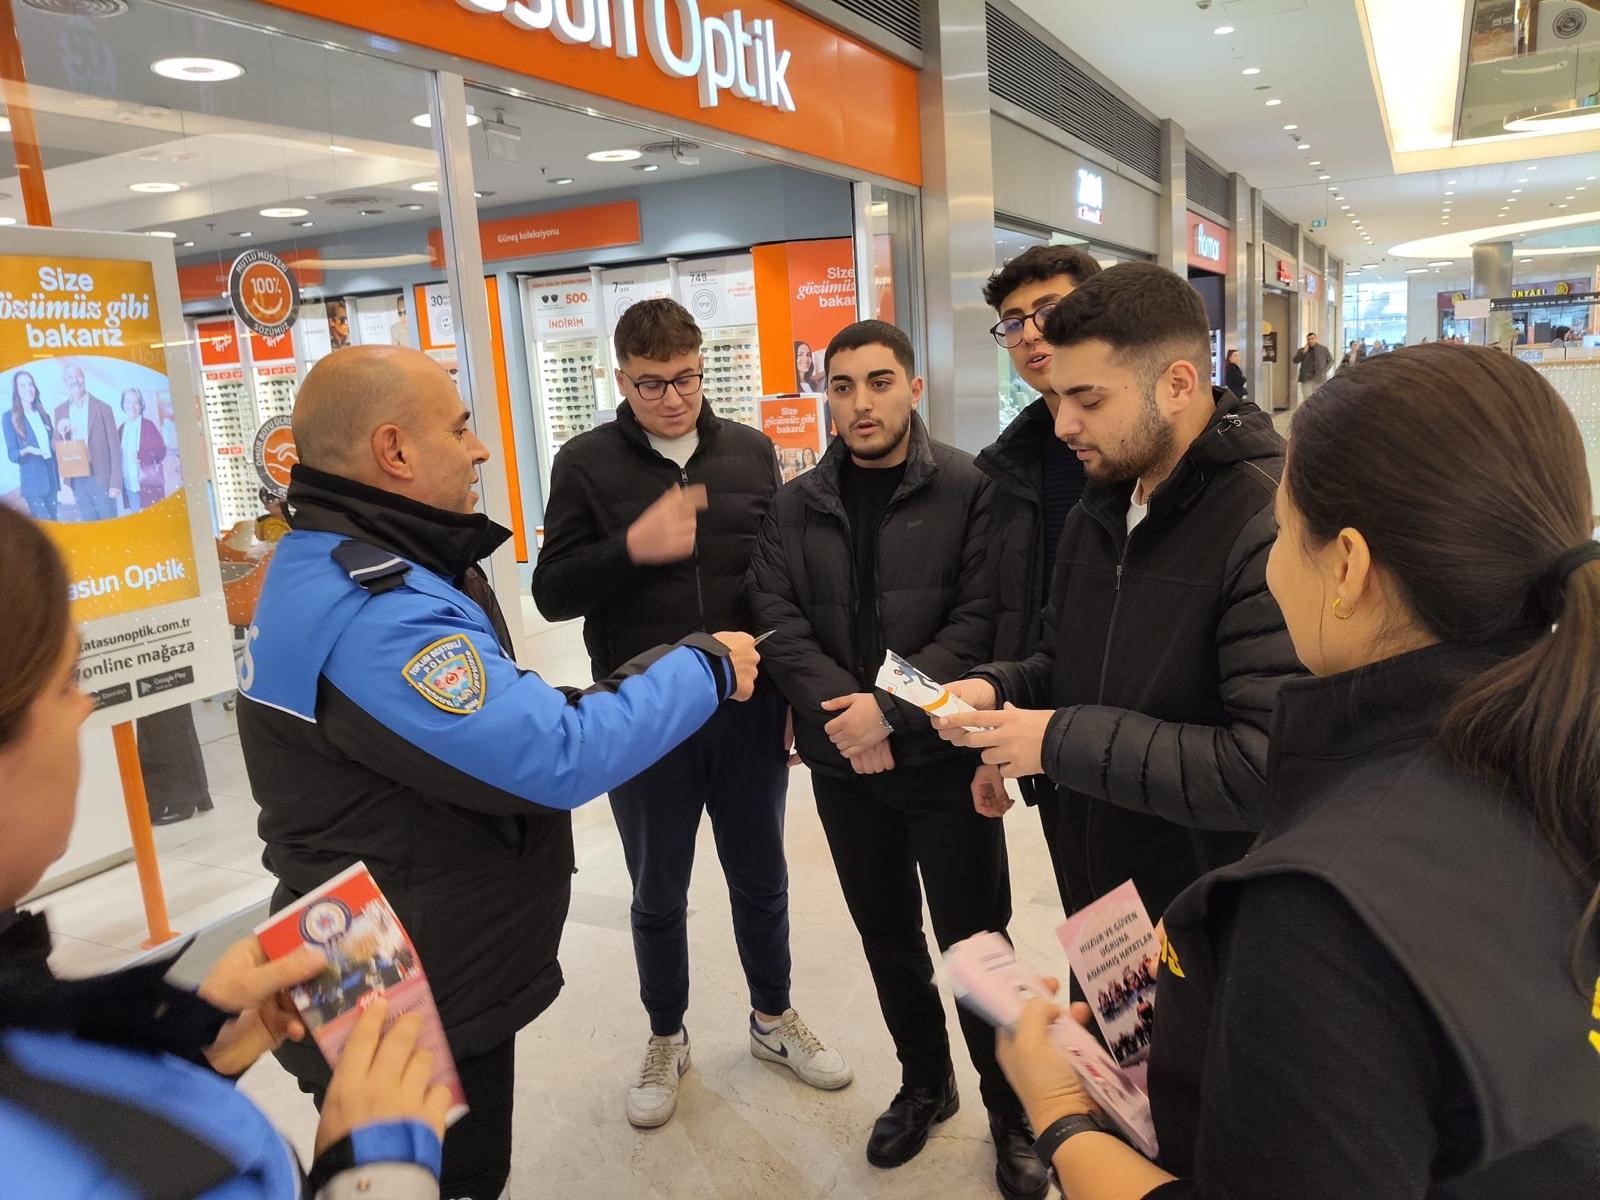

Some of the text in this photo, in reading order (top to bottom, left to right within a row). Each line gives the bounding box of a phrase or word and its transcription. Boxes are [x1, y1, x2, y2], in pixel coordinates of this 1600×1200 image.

[645, 0, 795, 111] Optik
[519, 228, 560, 240] koleksiyonu
[235, 251, 257, 273] MUTLU
[38, 266, 94, 292] Size
[690, 273, 707, 284] 749
[827, 267, 854, 279] Size
[250, 277, 281, 294] 100%
[612, 281, 619, 293] 7
[565, 292, 588, 304] 500
[1512, 288, 1546, 298] ÜNYASI
[430, 295, 443, 307] 30
[819, 294, 856, 308] bakar
[0, 291, 149, 328] özümüz gibi
[26, 323, 125, 348] bakarız
[781, 407, 798, 416] Size
[274, 416, 292, 426] ÜCRE
[67, 558, 186, 601] asun Optik
[137, 641, 196, 663] mağaza
